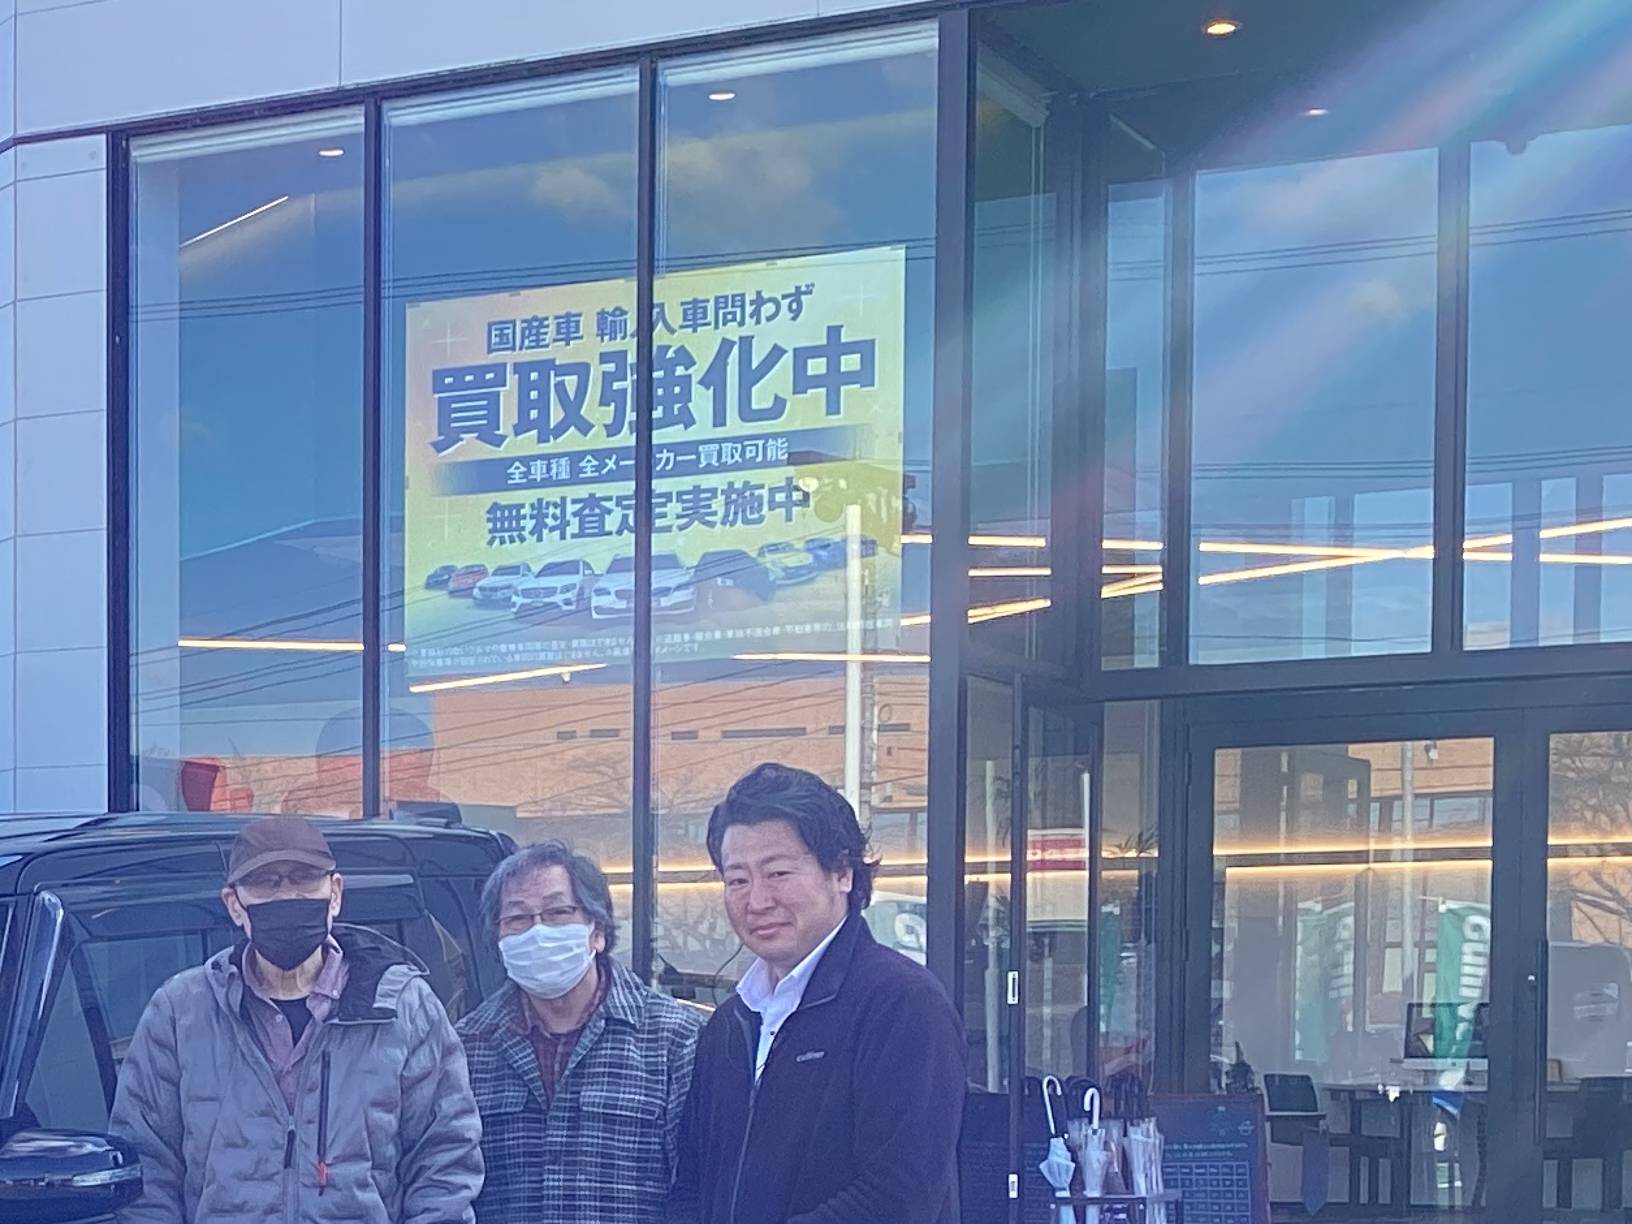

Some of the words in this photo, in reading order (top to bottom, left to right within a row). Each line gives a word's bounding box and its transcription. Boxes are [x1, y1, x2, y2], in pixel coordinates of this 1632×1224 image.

[486, 311, 584, 355] 国産車
[596, 283, 815, 343] 輸入車問わず
[430, 324, 877, 455] 買取強化中
[506, 456, 571, 484] 全車種
[485, 476, 811, 547] 無料査定実施中
